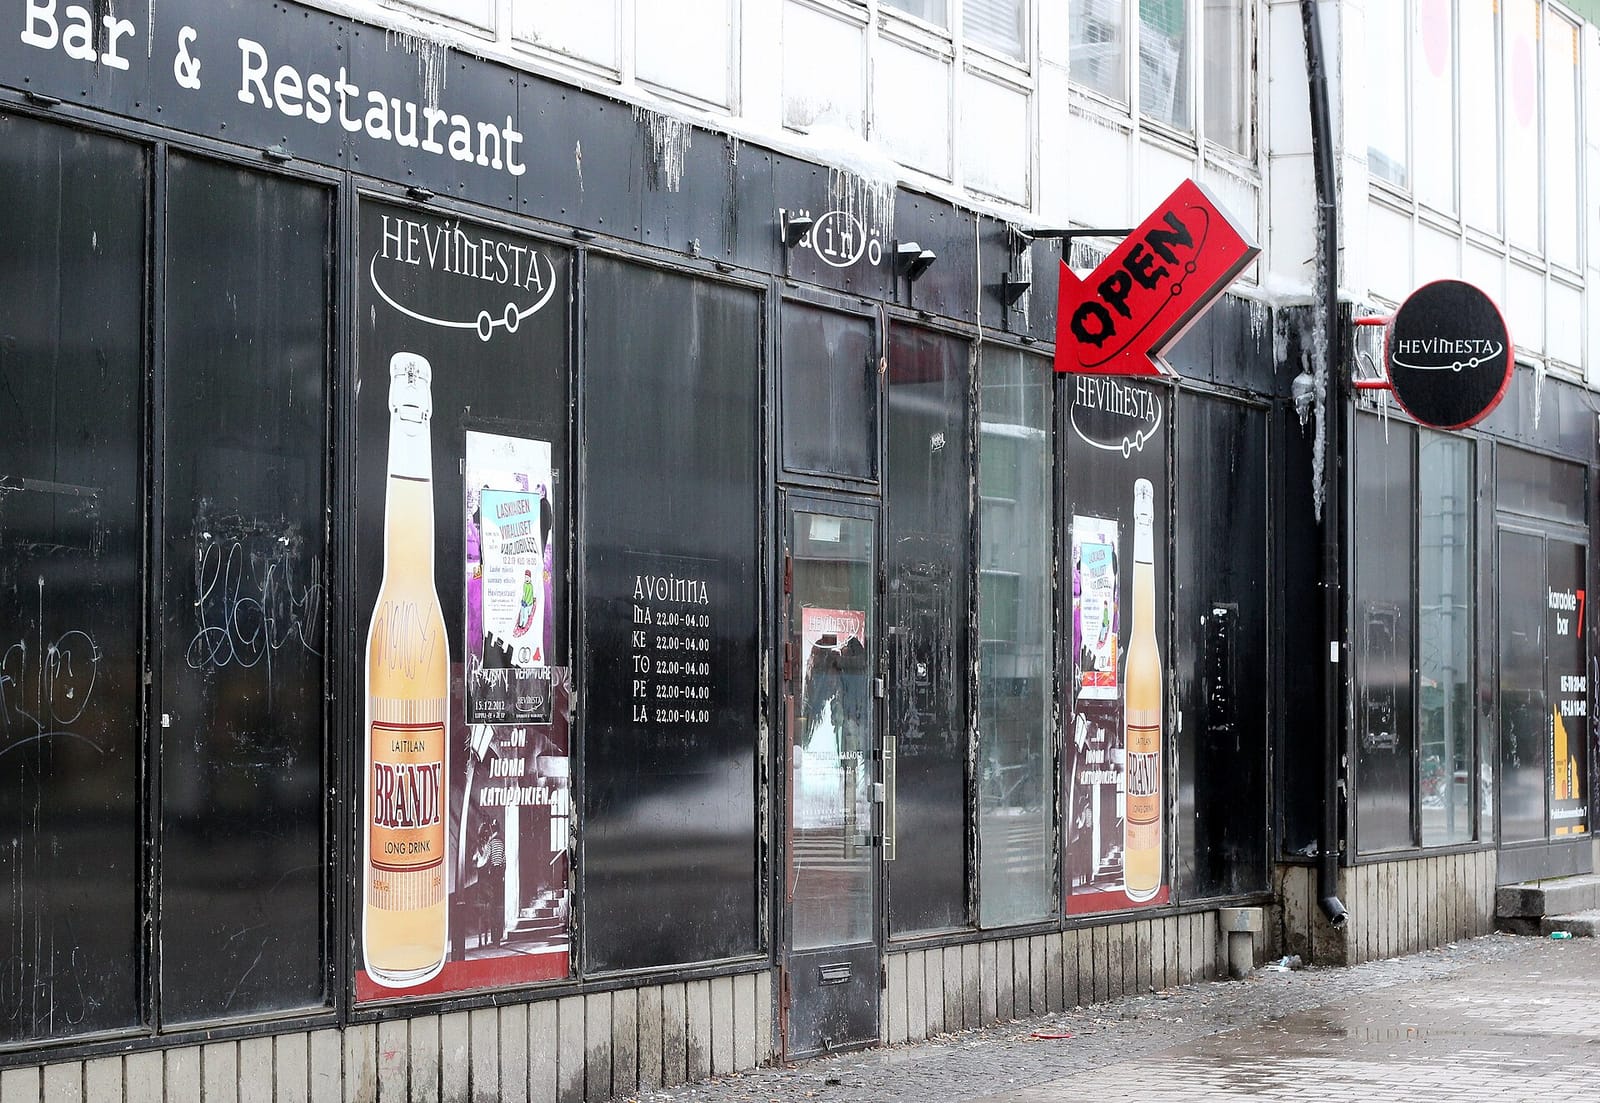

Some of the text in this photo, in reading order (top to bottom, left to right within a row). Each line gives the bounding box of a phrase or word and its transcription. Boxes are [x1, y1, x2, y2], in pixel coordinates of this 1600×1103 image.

[20, 0, 527, 177] Bar & Restaurant
[1070, 210, 1195, 349] OPEN
[633, 605, 710, 628] MA 22.00-04.00
[1548, 585, 1586, 639] karaoke 7
[1556, 612, 1569, 636] bar
[632, 631, 710, 652] KE 22.00-04.00
[632, 655, 710, 676] TO 22.00-04.00
[633, 680, 710, 699] PE 22.00-04.00
[633, 705, 710, 723] LA 22.00-04.00
[391, 739, 425, 753] LAITILAN
[489, 757, 525, 779] JUOMA
[374, 762, 441, 828] BRÄNDY
[384, 839, 432, 855] LONG DRINK
